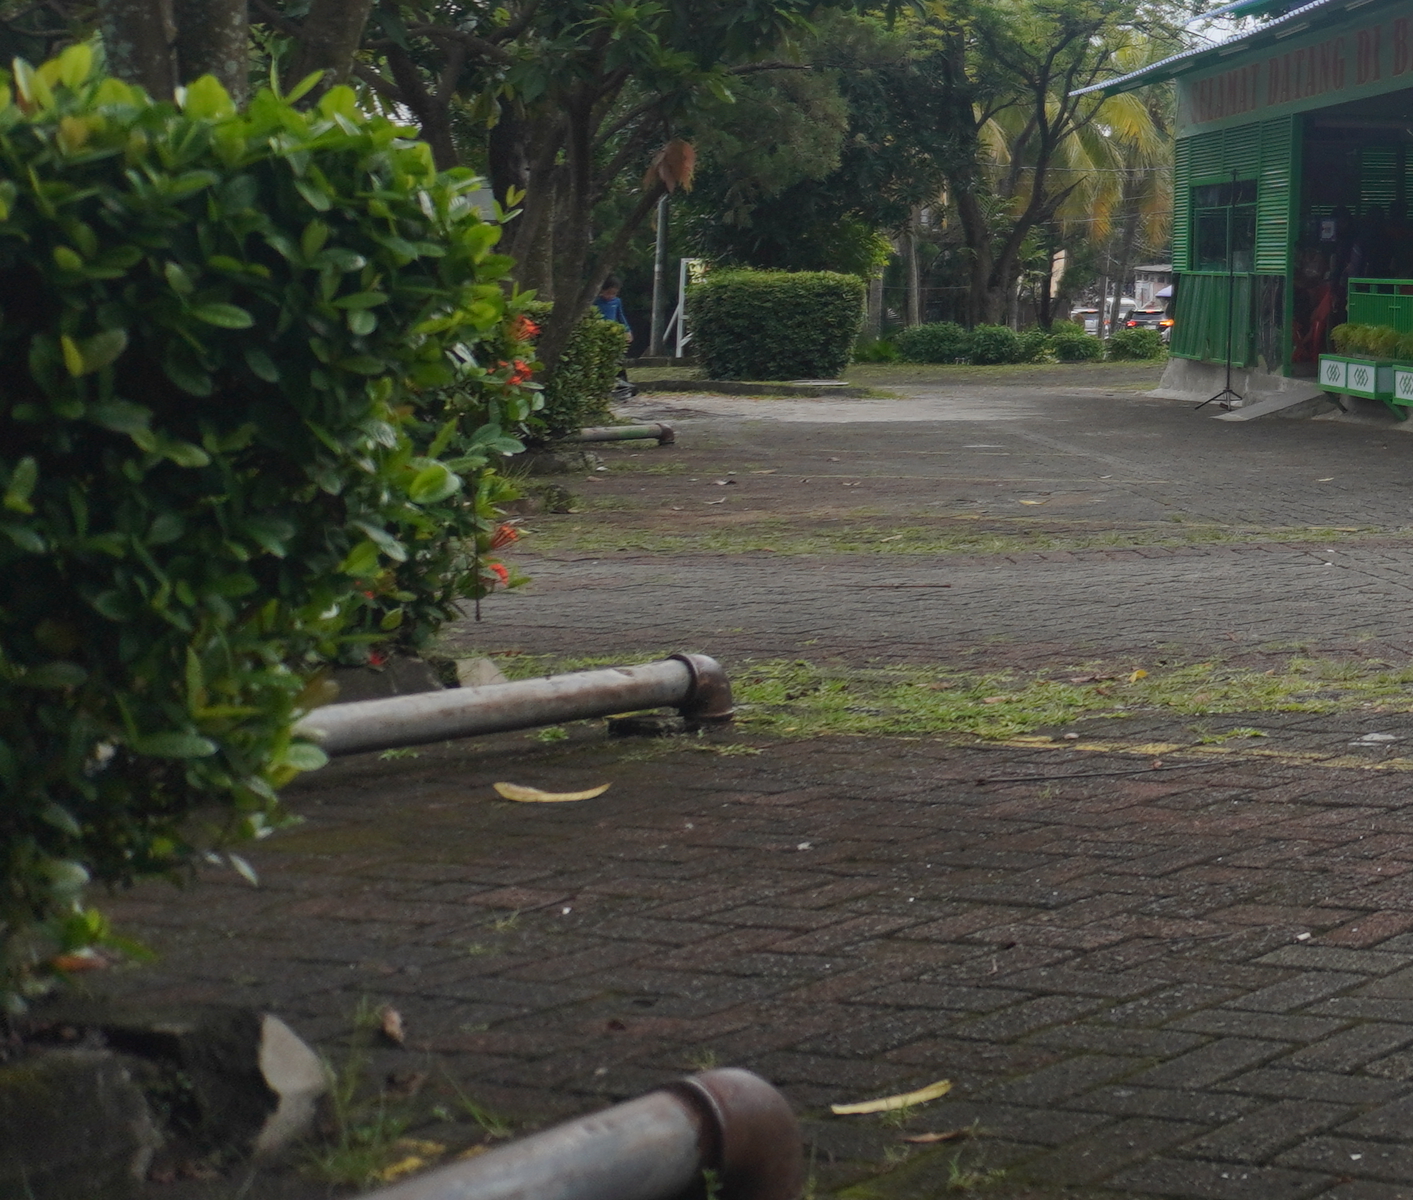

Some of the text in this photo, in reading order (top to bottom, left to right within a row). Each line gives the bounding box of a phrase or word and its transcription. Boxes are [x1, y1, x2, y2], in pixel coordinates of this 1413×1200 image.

[1191, 64, 1260, 123] SELAMAT
[1268, 36, 1345, 106] DATANG
[1355, 25, 1382, 85] DI
